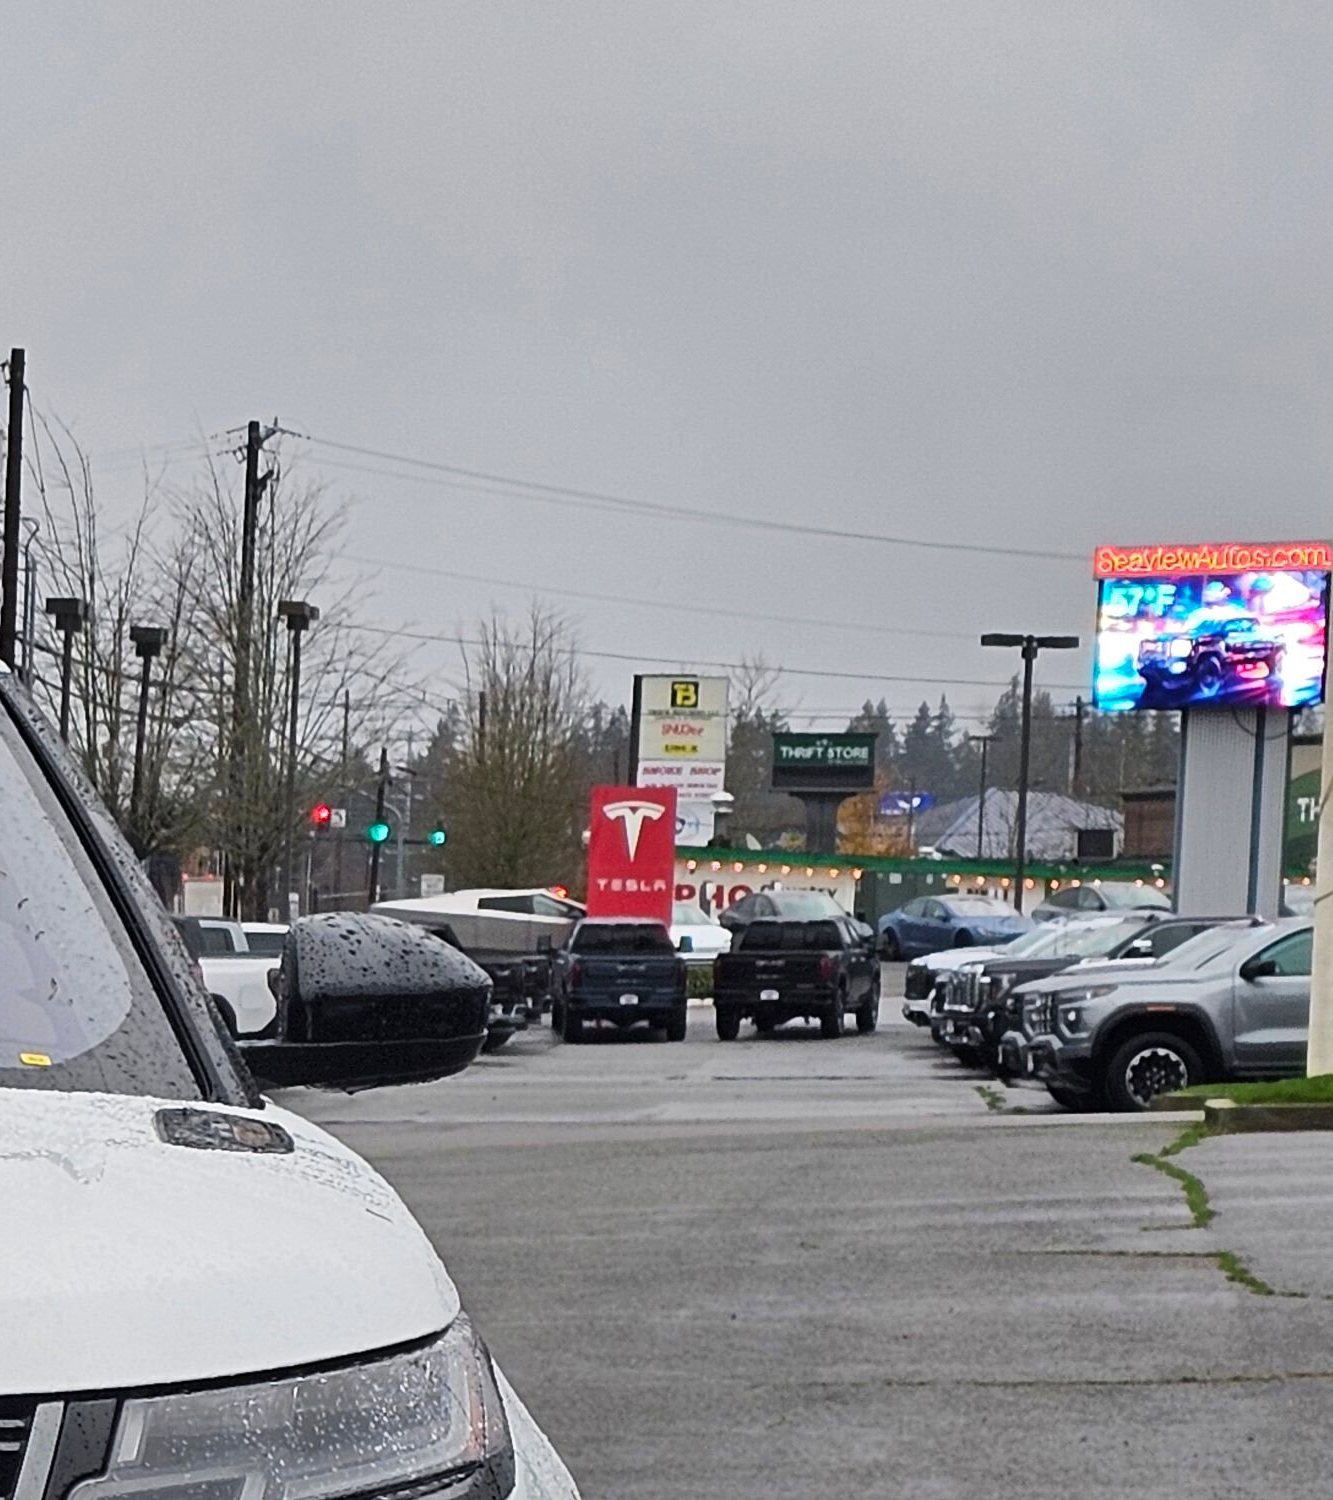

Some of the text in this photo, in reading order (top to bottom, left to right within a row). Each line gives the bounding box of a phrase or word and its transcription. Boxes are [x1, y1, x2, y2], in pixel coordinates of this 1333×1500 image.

[780, 746, 869, 759] THRIFT STORE
[597, 879, 667, 892] TESLA
